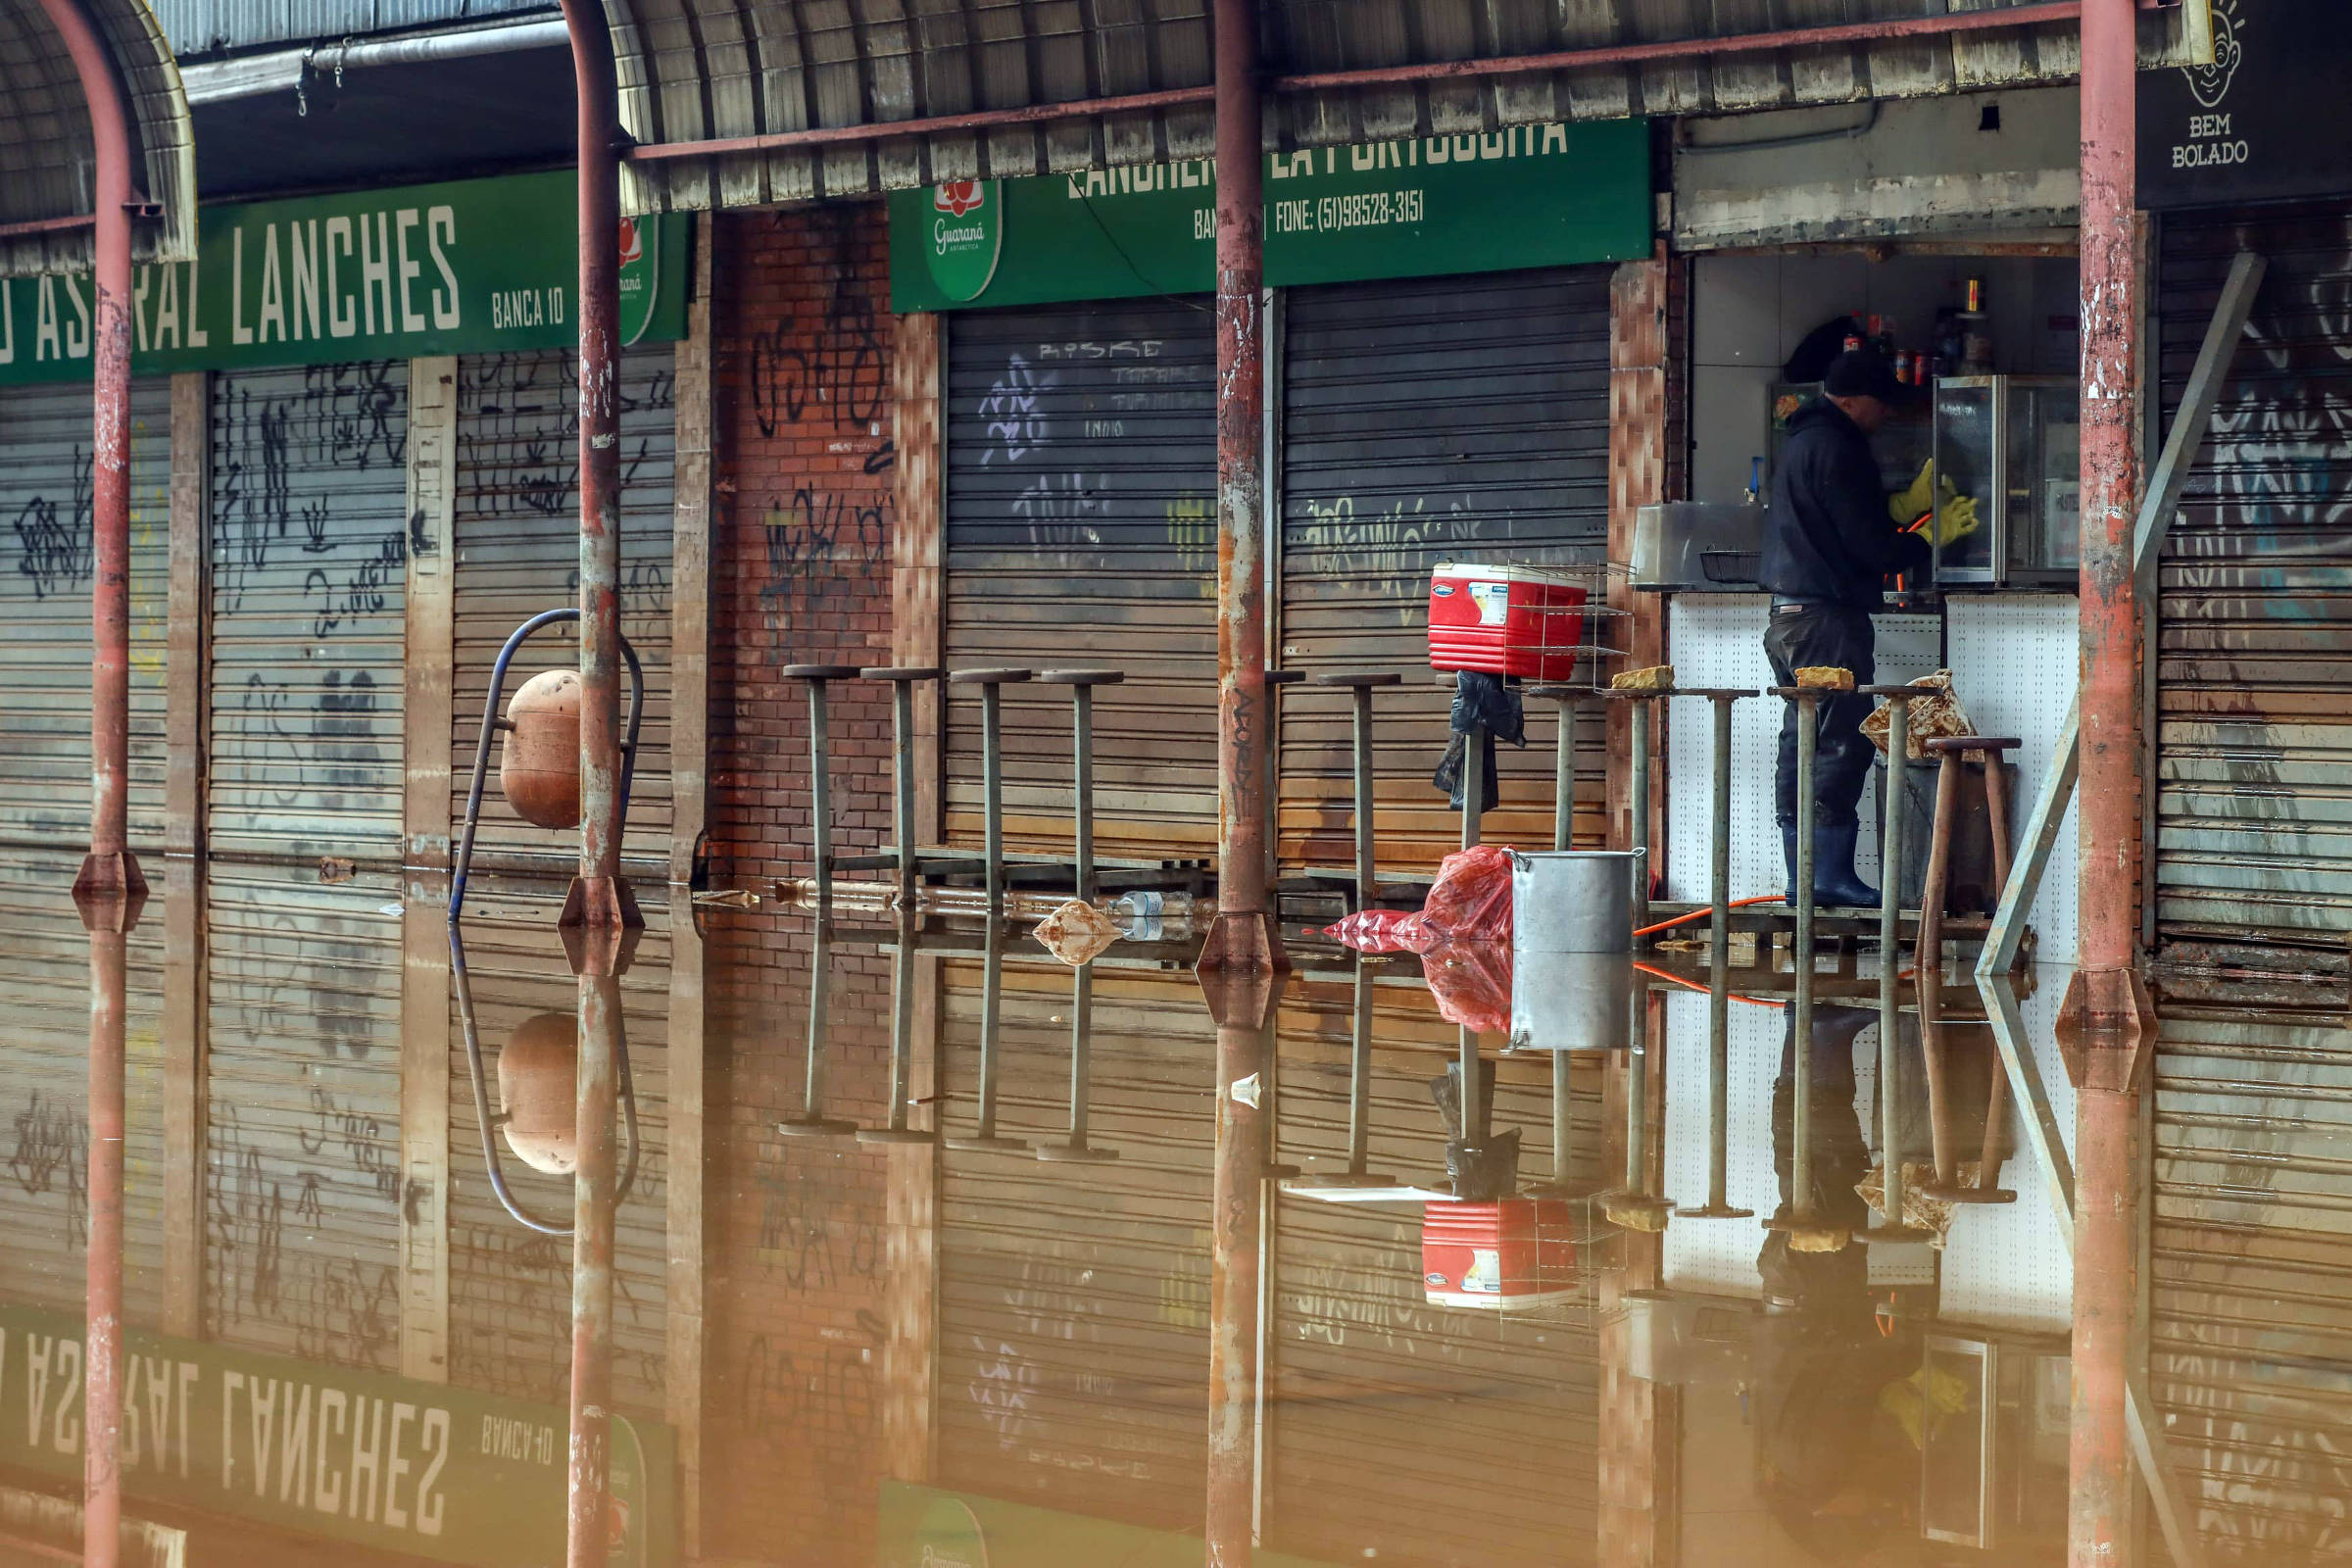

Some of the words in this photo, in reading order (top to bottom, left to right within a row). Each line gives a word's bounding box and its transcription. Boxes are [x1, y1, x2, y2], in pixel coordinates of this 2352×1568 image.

[2190, 113, 2230, 137] BEM
[2172, 140, 2248, 168] BOLADO
[1276, 200, 1313, 232] FONE:
[1317, 189, 1423, 232] (51)98528-3151
[934, 218, 985, 255] Guaraná
[232, 205, 461, 345] LANCHES
[492, 290, 543, 329] BANCA
[548, 287, 564, 324] 10
